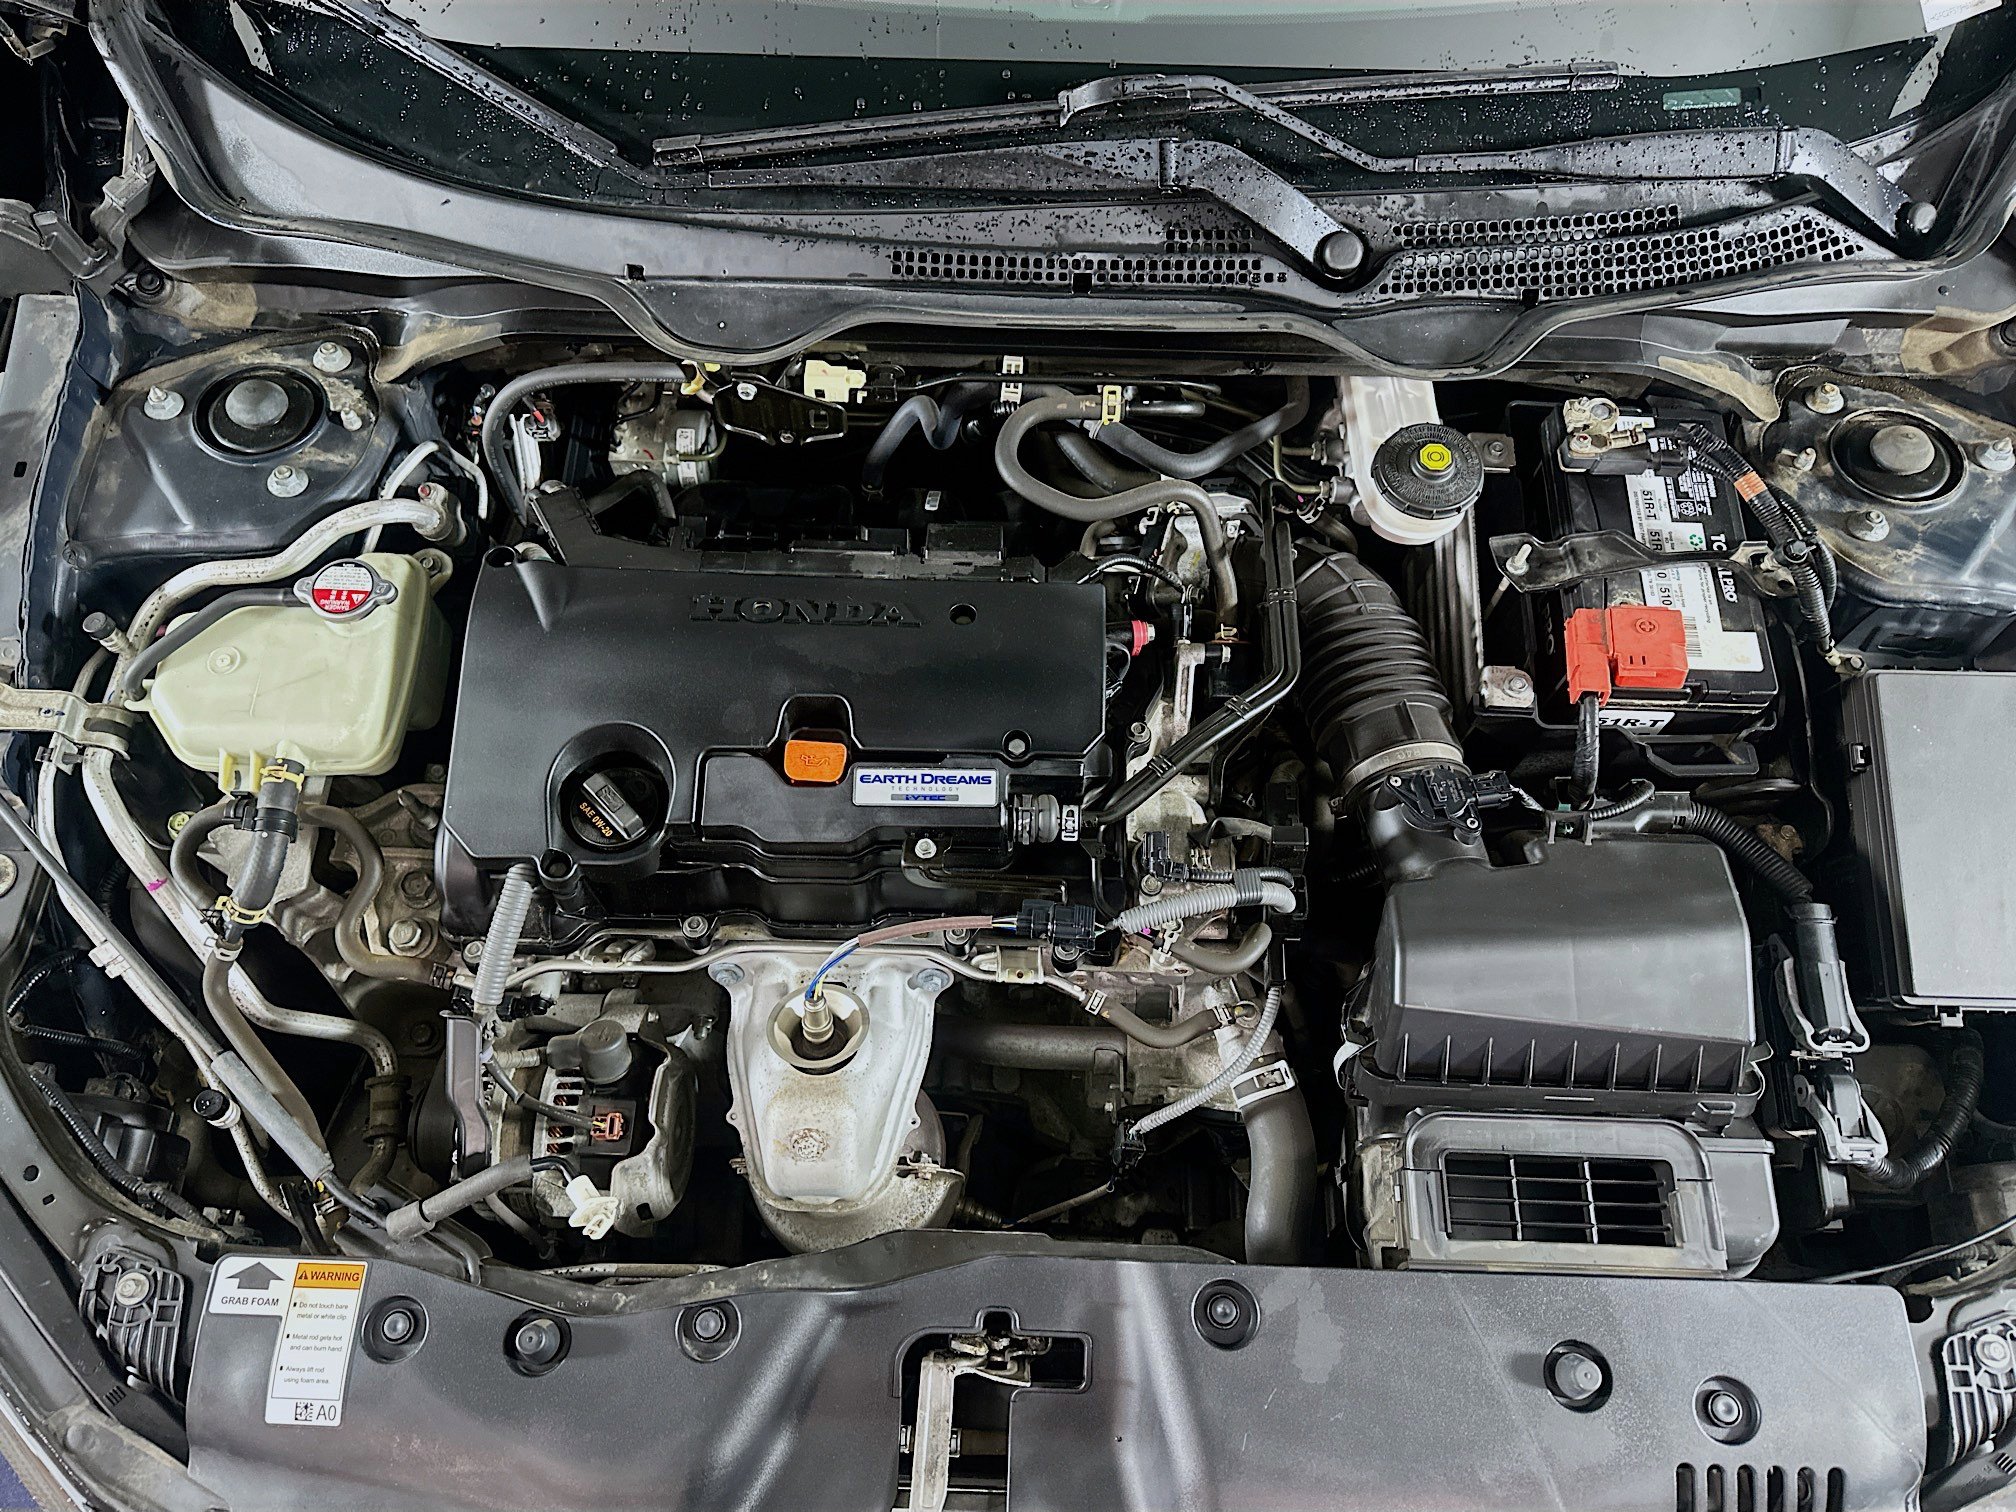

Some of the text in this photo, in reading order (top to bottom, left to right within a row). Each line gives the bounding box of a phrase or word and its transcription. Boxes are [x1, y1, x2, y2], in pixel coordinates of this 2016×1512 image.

[1642, 490, 1657, 520] 51R-T
[1650, 531, 1662, 551] 51R
[1660, 587, 1672, 606] 510
[689, 597, 922, 626] HONDA
[1598, 718, 1664, 728] 51R-T
[860, 774, 992, 785] EARTH DREAMS
[580, 802, 613, 837] SAE 0W-20
[310, 1271, 360, 1282] WARNING
[221, 1296, 279, 1306] GRAB FOAM
[316, 1405, 336, 1421] A0
